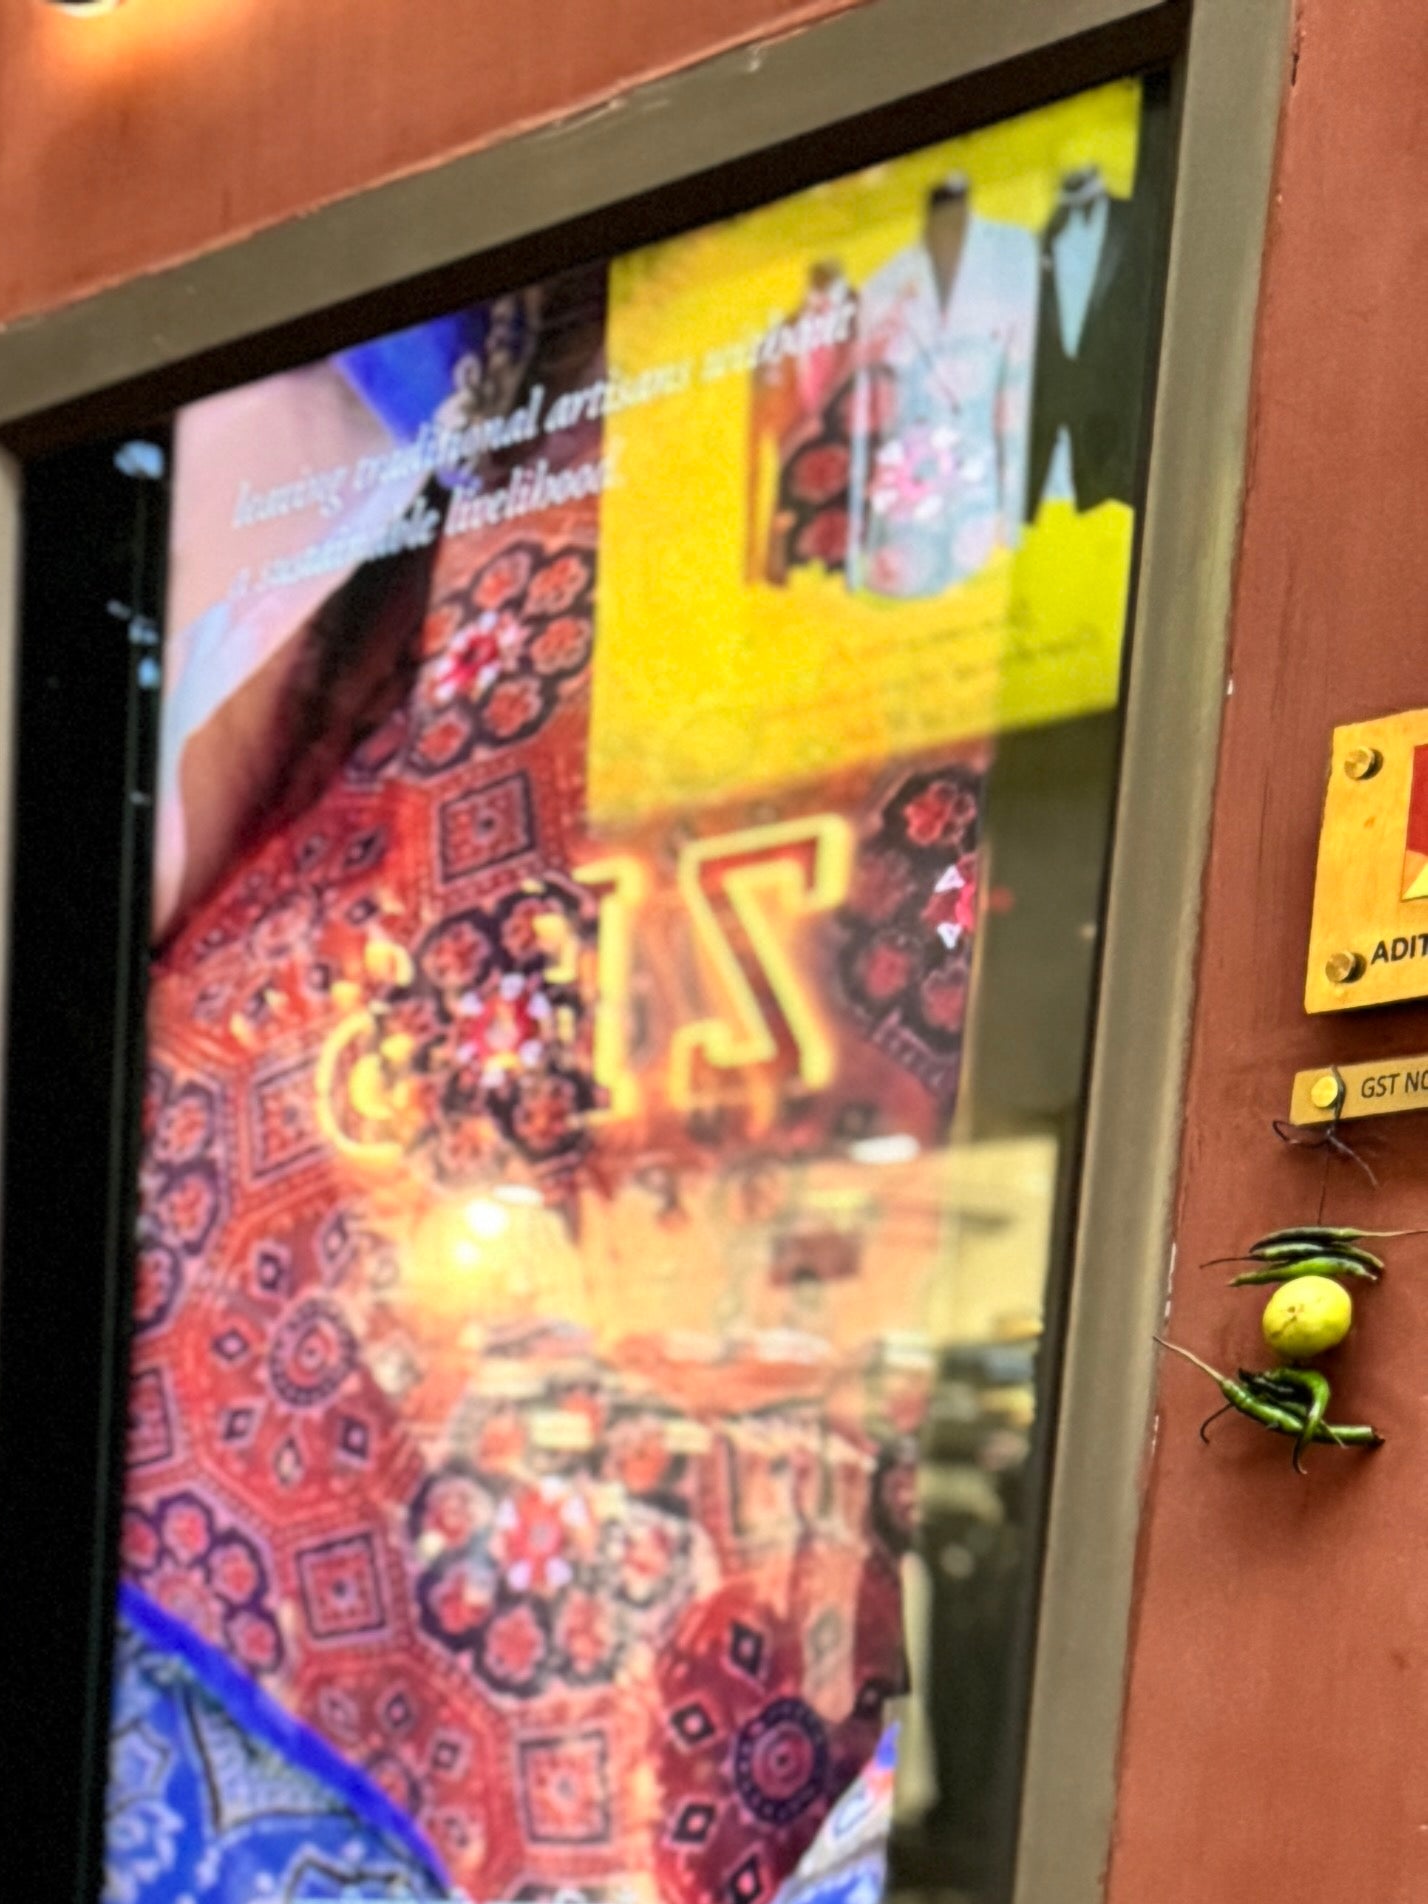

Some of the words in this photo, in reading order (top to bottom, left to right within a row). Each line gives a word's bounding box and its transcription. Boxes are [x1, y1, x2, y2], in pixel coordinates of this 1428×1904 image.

[353, 384, 544, 491] traditional
[543, 360, 693, 432] artisans
[1361, 1073, 1400, 1099] GST
